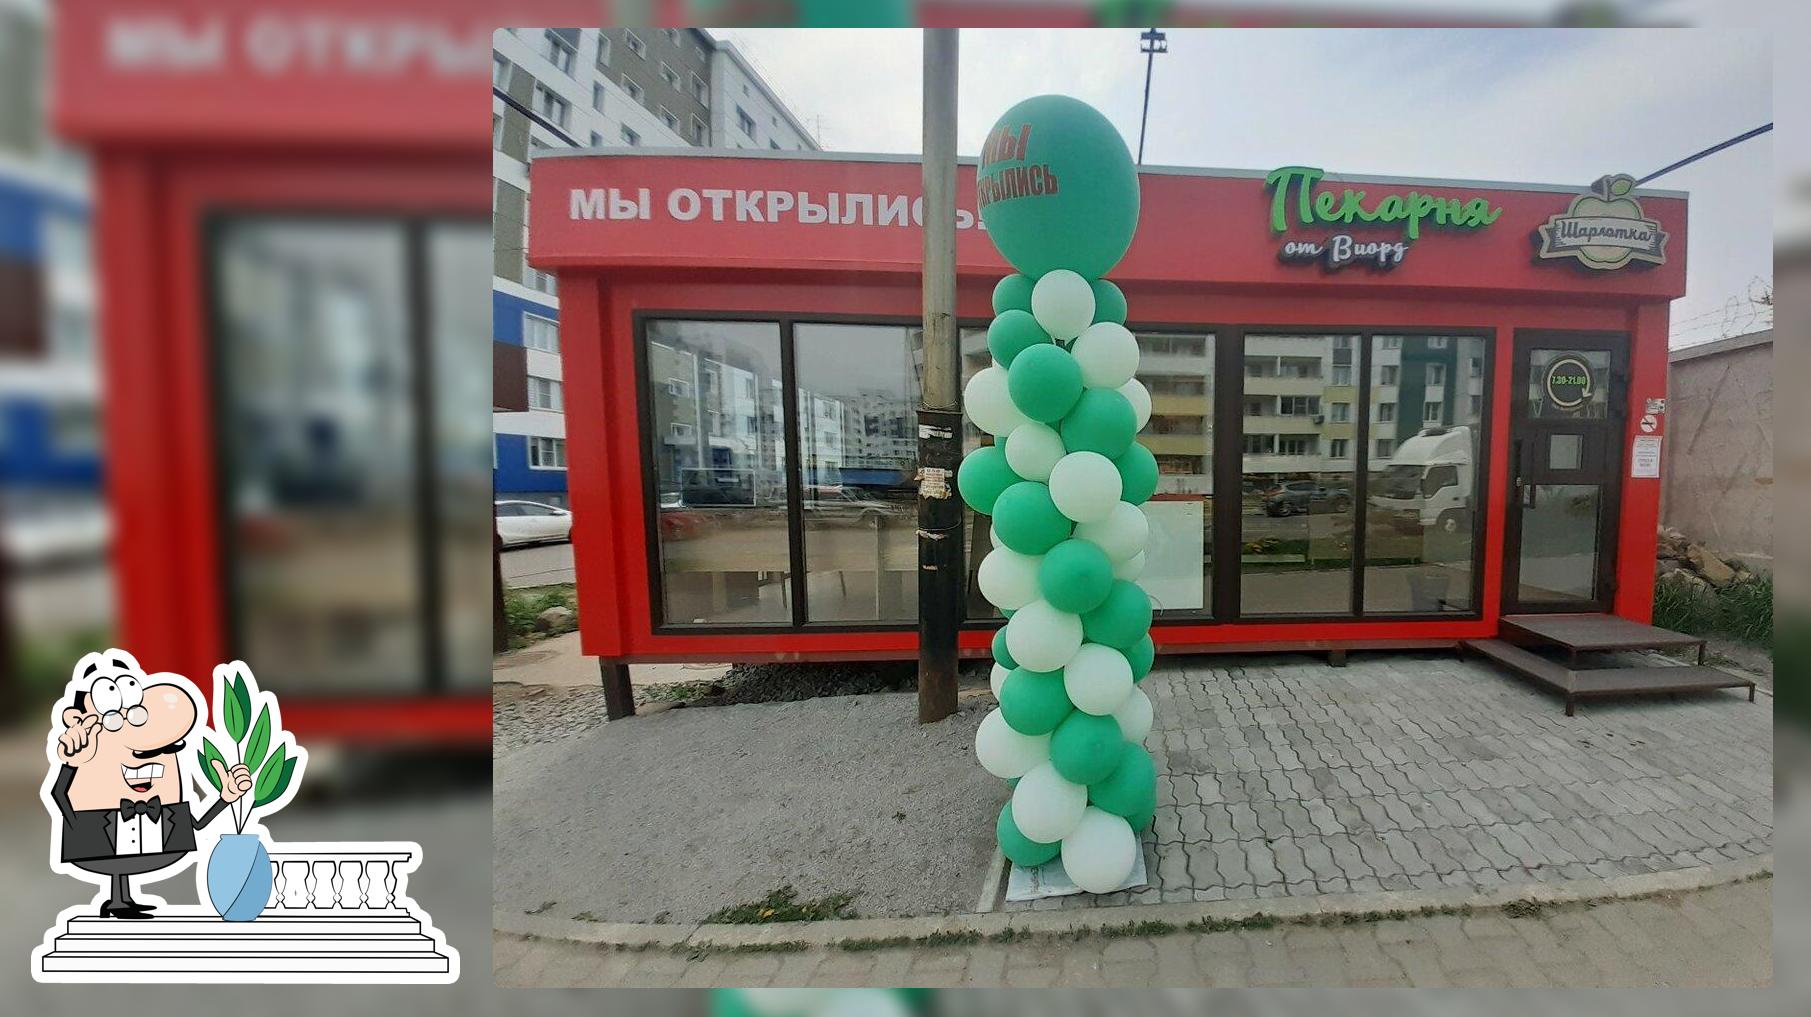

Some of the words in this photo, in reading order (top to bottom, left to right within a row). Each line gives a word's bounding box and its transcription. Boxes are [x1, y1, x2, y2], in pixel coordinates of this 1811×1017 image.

[570, 188, 651, 220] МЫ
[1264, 165, 1503, 240] Пекарня
[1559, 220, 1652, 242] Шарлотка
[1284, 241, 1323, 256] от
[1331, 234, 1408, 263] Виорд
